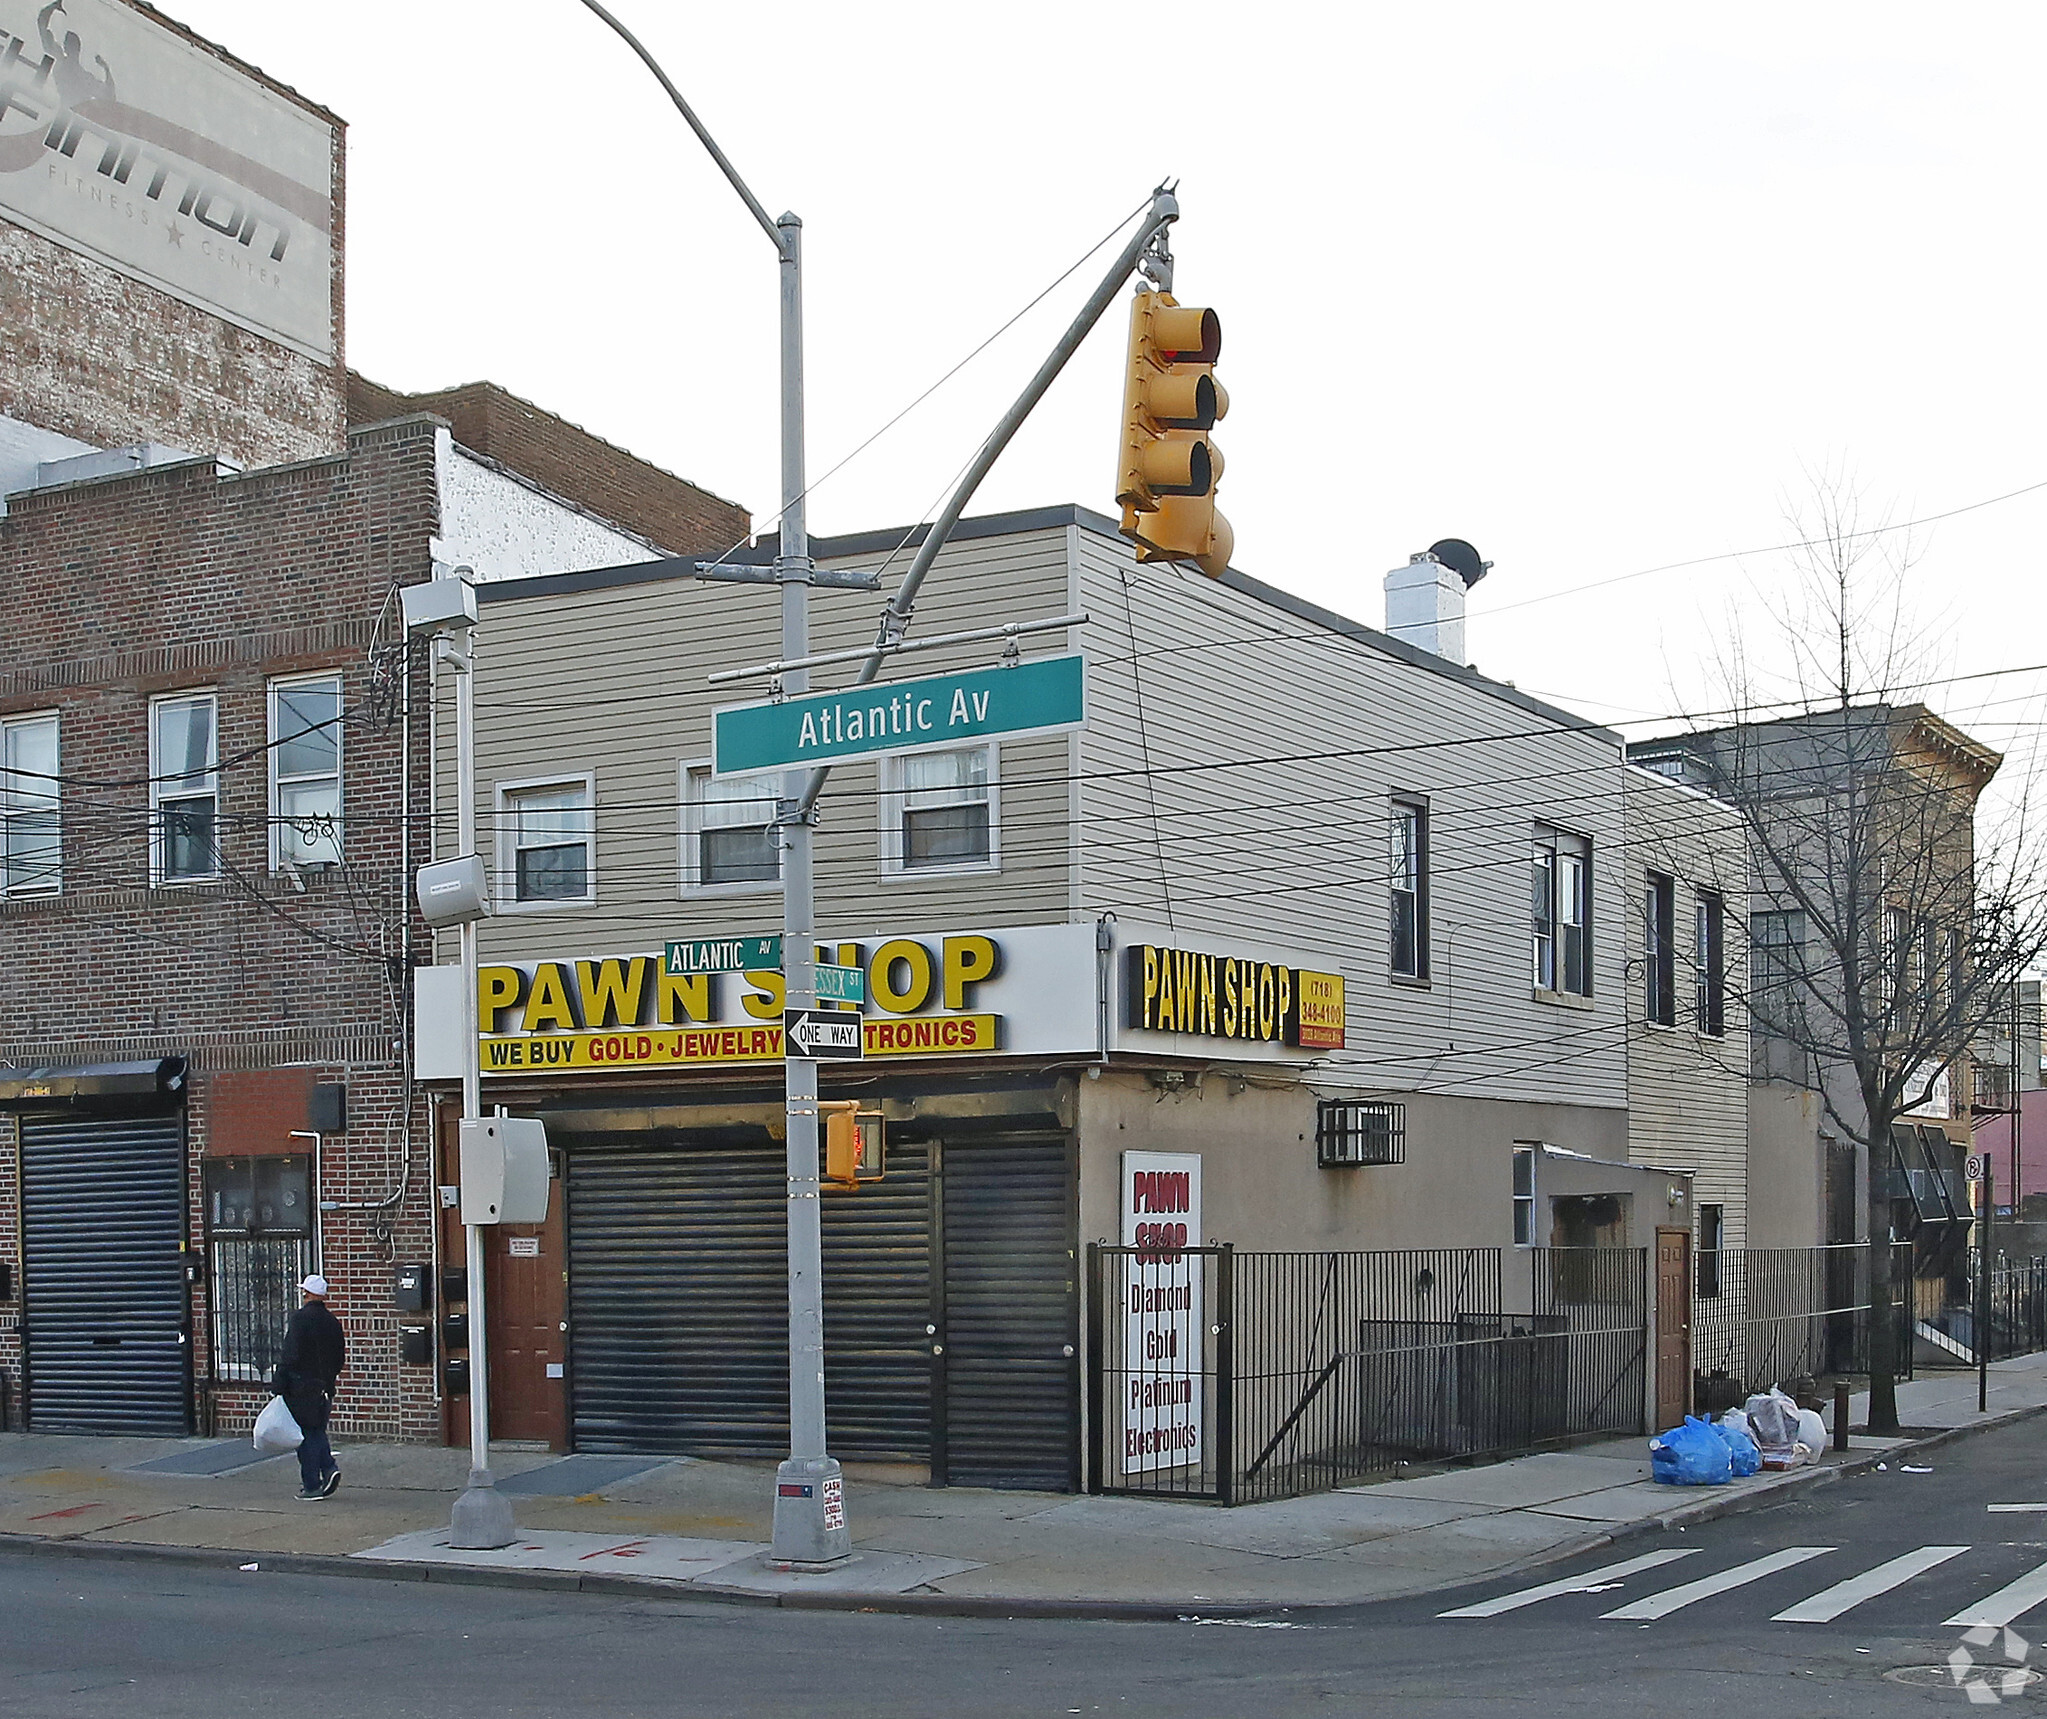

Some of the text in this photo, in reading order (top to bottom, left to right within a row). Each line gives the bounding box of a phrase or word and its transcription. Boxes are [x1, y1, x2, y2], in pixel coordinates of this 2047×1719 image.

[48, 163, 281, 290] FITNESS CENTER
[797, 687, 991, 749] Atlantic Av
[670, 940, 772, 972] ATLANTIC AV
[478, 955, 709, 1033] PAWN
[849, 971, 860, 987] ST
[1143, 944, 1291, 1042] PAWN SHOP
[1310, 980, 1333, 999] (718)
[490, 1020, 977, 1066] WE BUY GOLD JEWELRY TRONICS
[799, 1024, 854, 1045] ONE WAY
[1133, 1171, 1190, 1214] PAWN
[1135, 1222, 1188, 1265] SHOP
[1147, 1329, 1177, 1361] Gold
[1131, 1377, 1192, 1410] Patinum
[1126, 1422, 1197, 1457] Electronics
